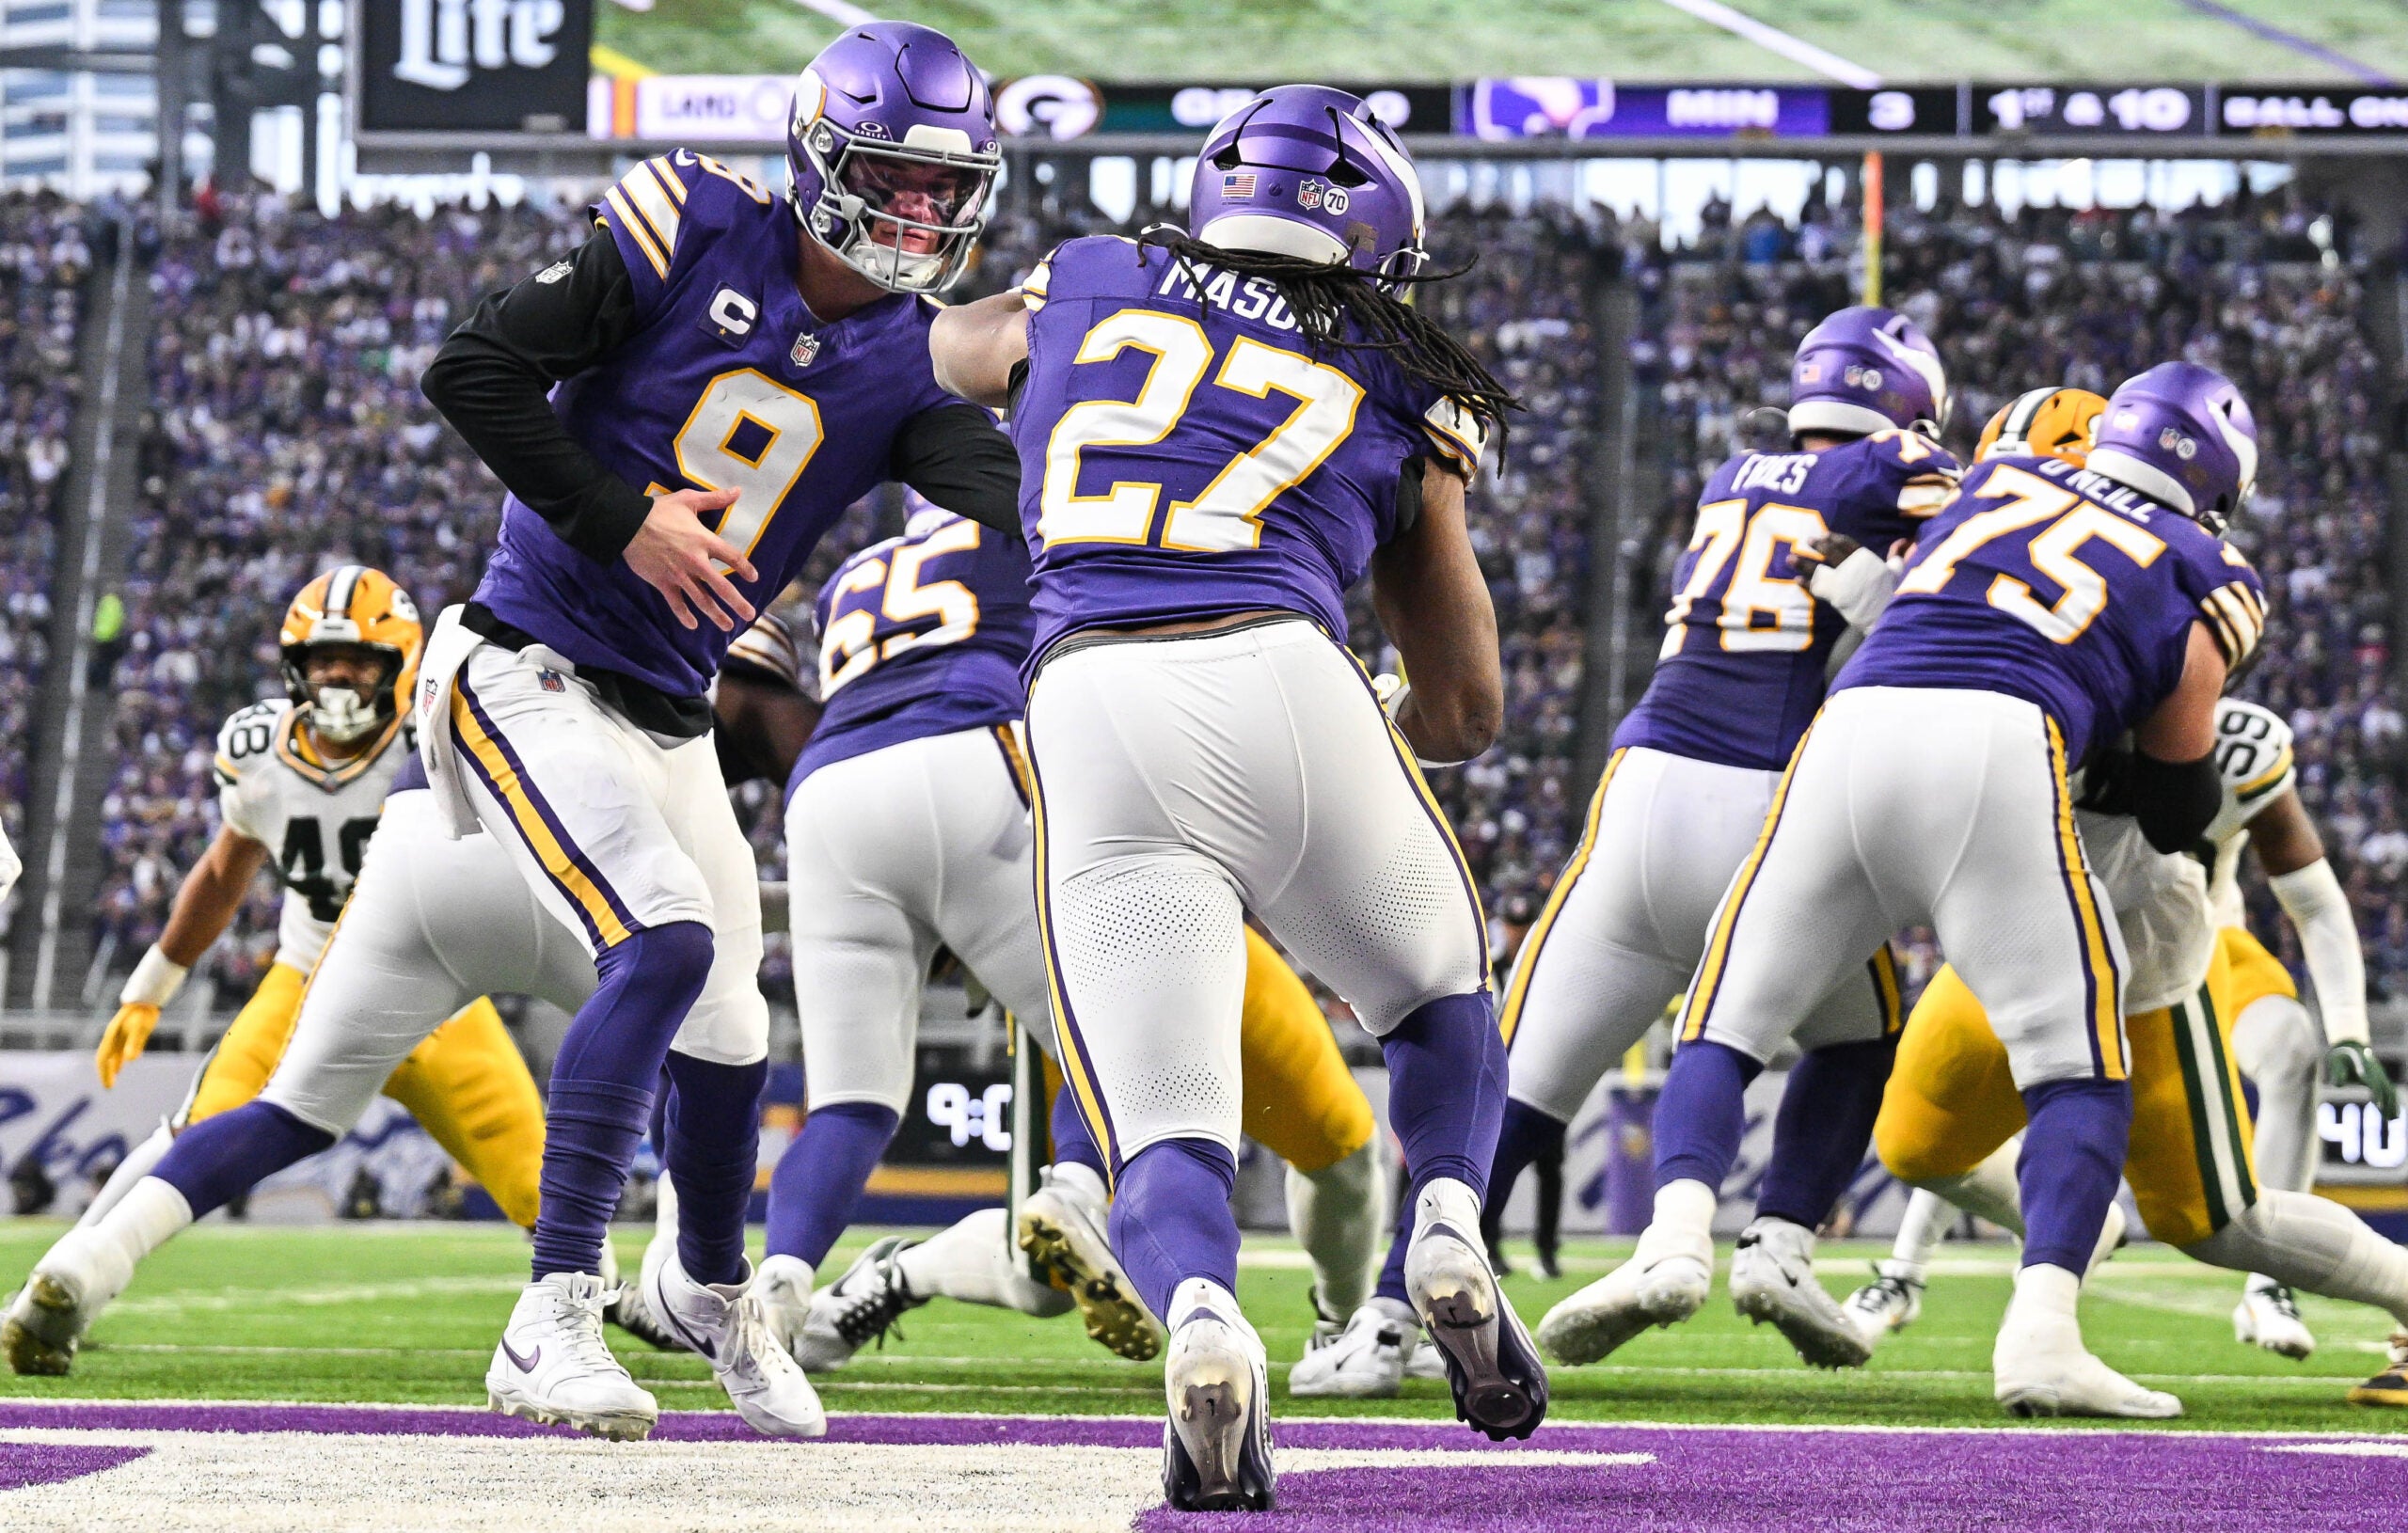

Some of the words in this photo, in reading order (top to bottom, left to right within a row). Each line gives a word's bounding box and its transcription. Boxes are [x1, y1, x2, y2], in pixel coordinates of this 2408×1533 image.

[1868, 91, 1915, 130] 3
[2108, 87, 2192, 131] 10
[1327, 192, 1345, 211] 70
[709, 288, 757, 335] C
[1159, 257, 1341, 336] MASO
[1037, 308, 1366, 552] 27
[643, 367, 824, 577] 9
[2038, 459, 2158, 524] ONEILL
[1658, 498, 1829, 661] 76
[1894, 464, 2166, 643] 75
[819, 518, 980, 703] 65
